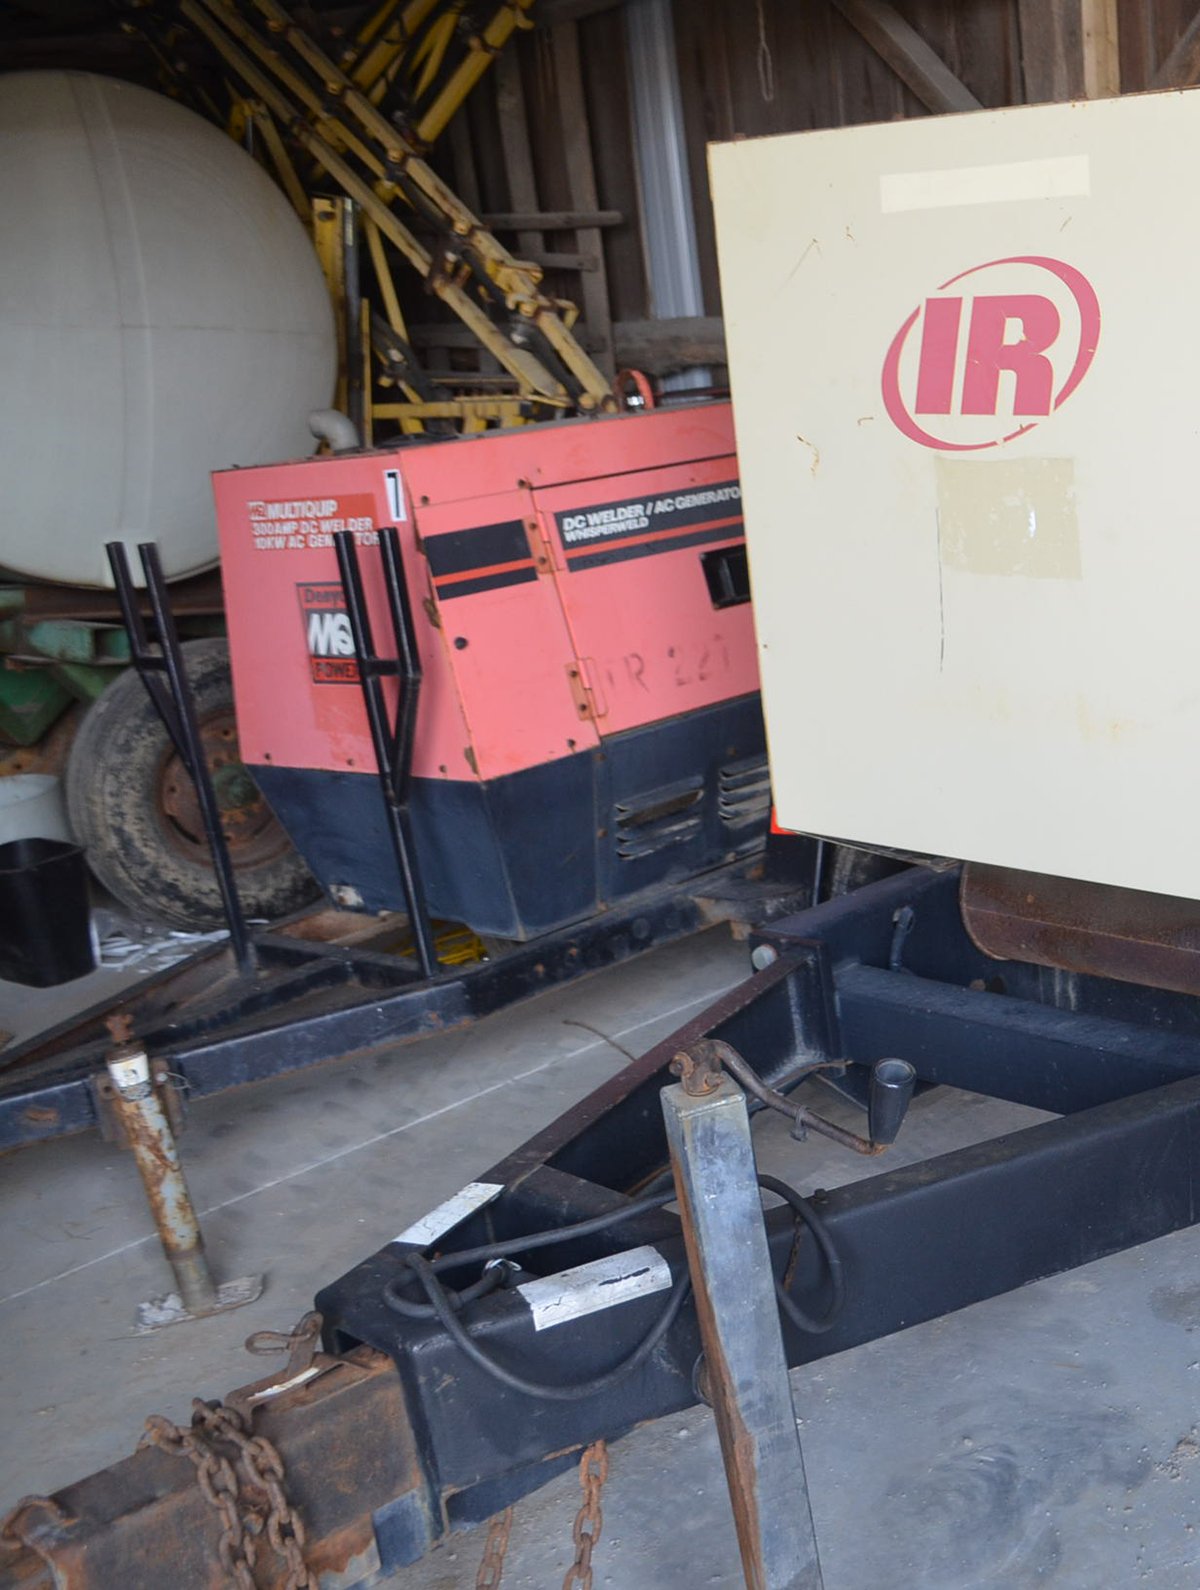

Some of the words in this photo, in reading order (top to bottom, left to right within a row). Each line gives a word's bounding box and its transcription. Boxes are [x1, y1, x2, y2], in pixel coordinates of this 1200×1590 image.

[915, 294, 1061, 416] IR
[267, 499, 338, 519] MULTIQUIP
[563, 514, 587, 531] DC
[587, 504, 645, 527] WELDER
[654, 499, 675, 514] AC
[674, 486, 742, 510] GENERATO
[299, 520, 319, 534] DC
[563, 516, 649, 543] WHISPERWELD
[255, 536, 287, 550] 10KW
[287, 535, 305, 549] AC
[308, 531, 380, 548] GENTOR
[315, 661, 358, 678] POWE
